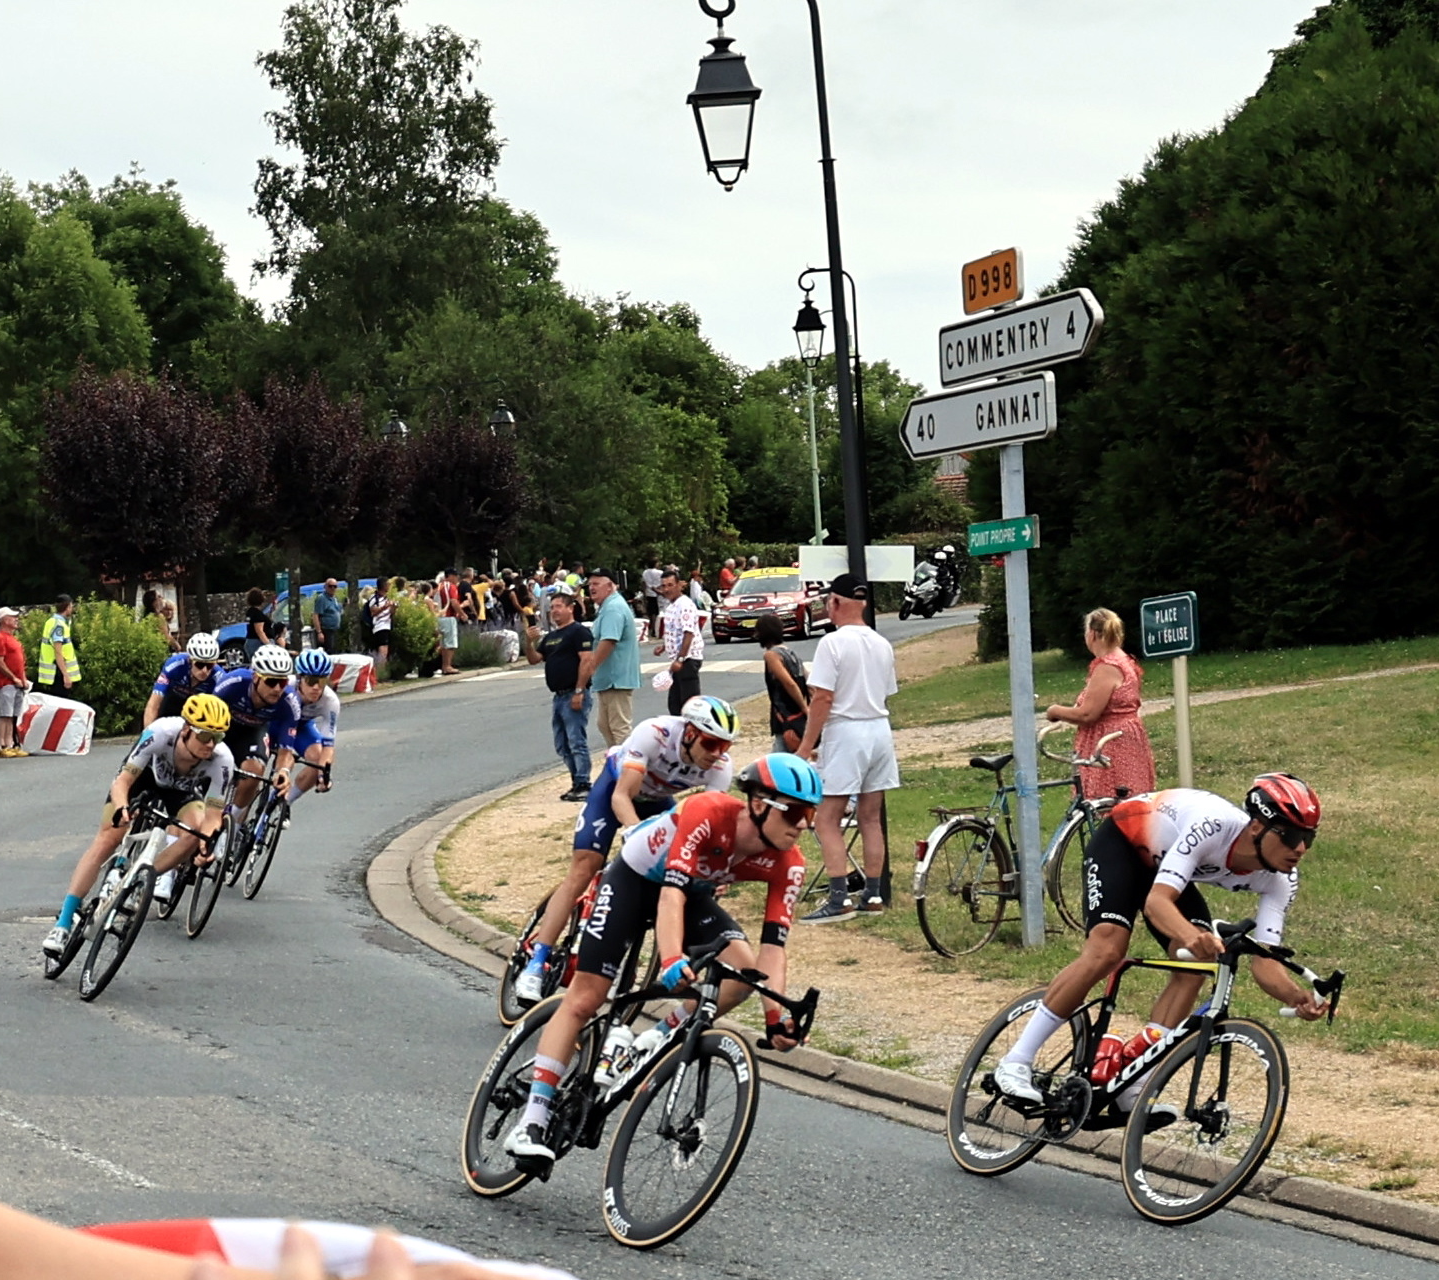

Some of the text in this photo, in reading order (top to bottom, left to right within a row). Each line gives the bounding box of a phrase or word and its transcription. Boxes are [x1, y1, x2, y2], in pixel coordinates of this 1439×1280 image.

[969, 261, 1012, 301] D 998
[946, 310, 1076, 369] COMMENTRY 4
[917, 392, 1040, 442] 40 GANNAT
[971, 527, 1016, 547] POINT PROPRE
[1155, 608, 1177, 623] PLACE
[1147, 632, 1155, 646] de
[680, 818, 712, 861] dstny
[586, 884, 614, 940] dstny
[718, 1036, 743, 1062] SWISS
[1107, 1019, 1191, 1093] LOOK
[1134, 1168, 1205, 1207] CORIMA
[604, 1187, 631, 1237] DT SWISS
